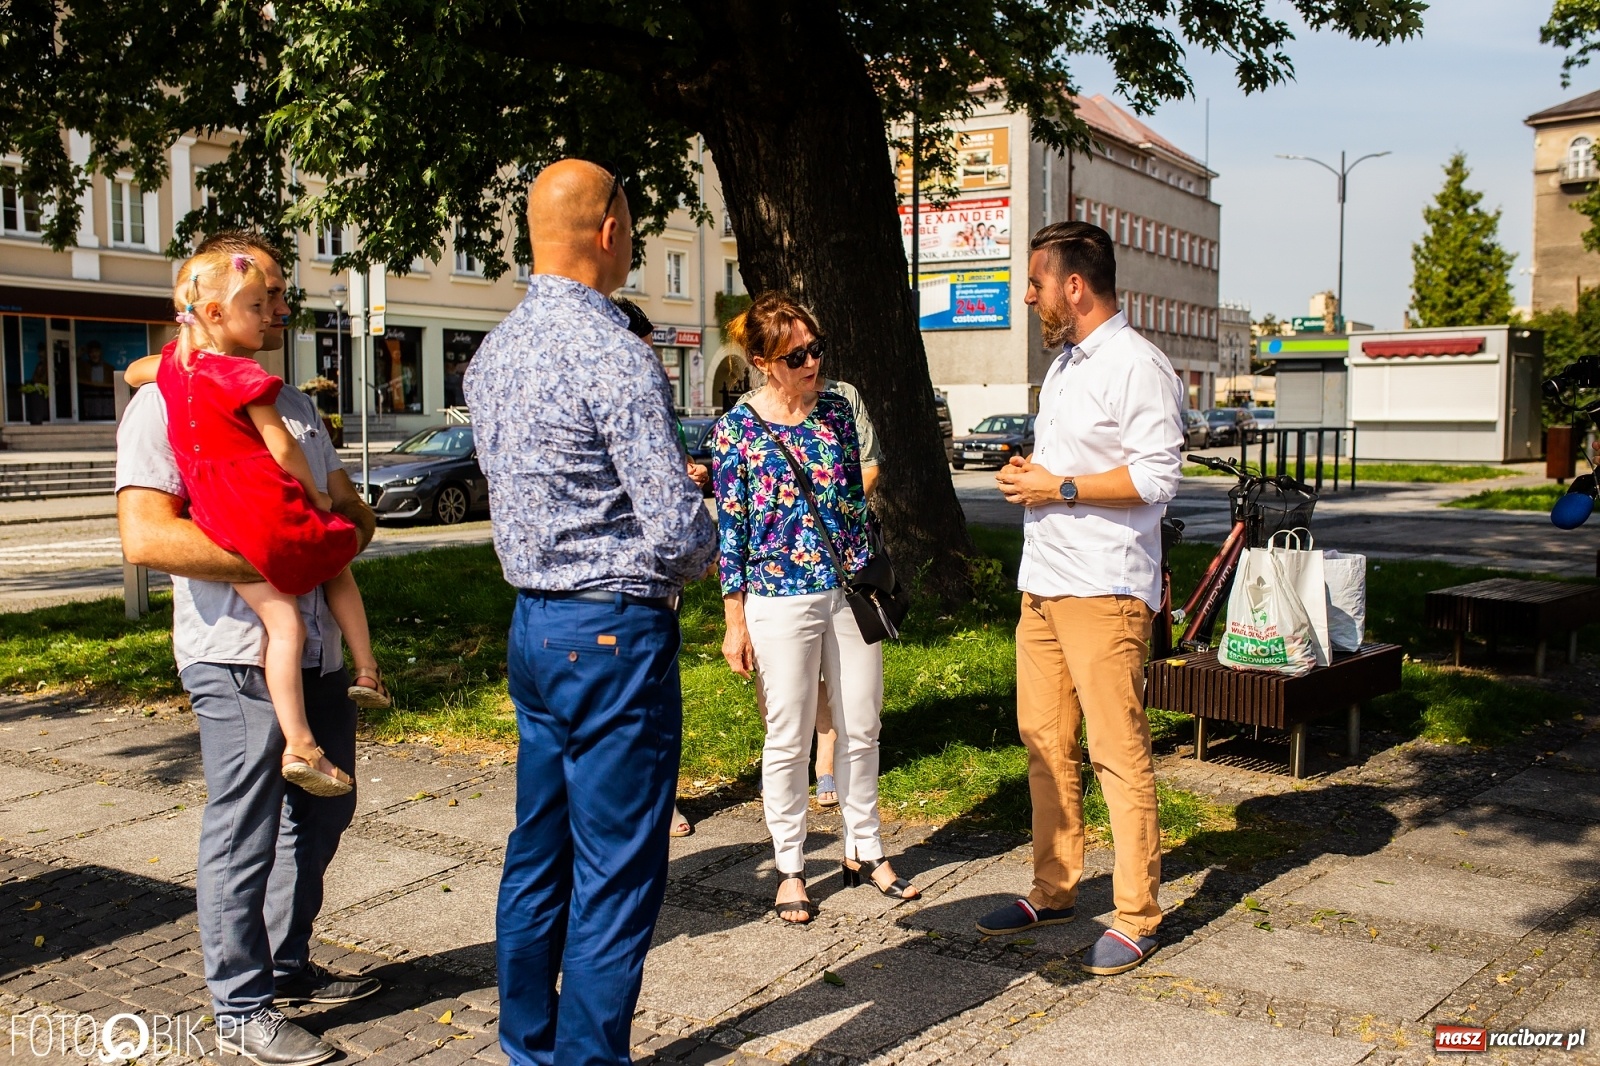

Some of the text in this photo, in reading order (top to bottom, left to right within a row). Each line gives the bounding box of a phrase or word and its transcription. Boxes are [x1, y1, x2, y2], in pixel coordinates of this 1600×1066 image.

[904, 210, 1004, 226] AEXANDER
[903, 226, 938, 236] MBLE
[956, 299, 986, 315] 244
[952, 314, 998, 323] castorama
[652, 331, 666, 340] ACE
